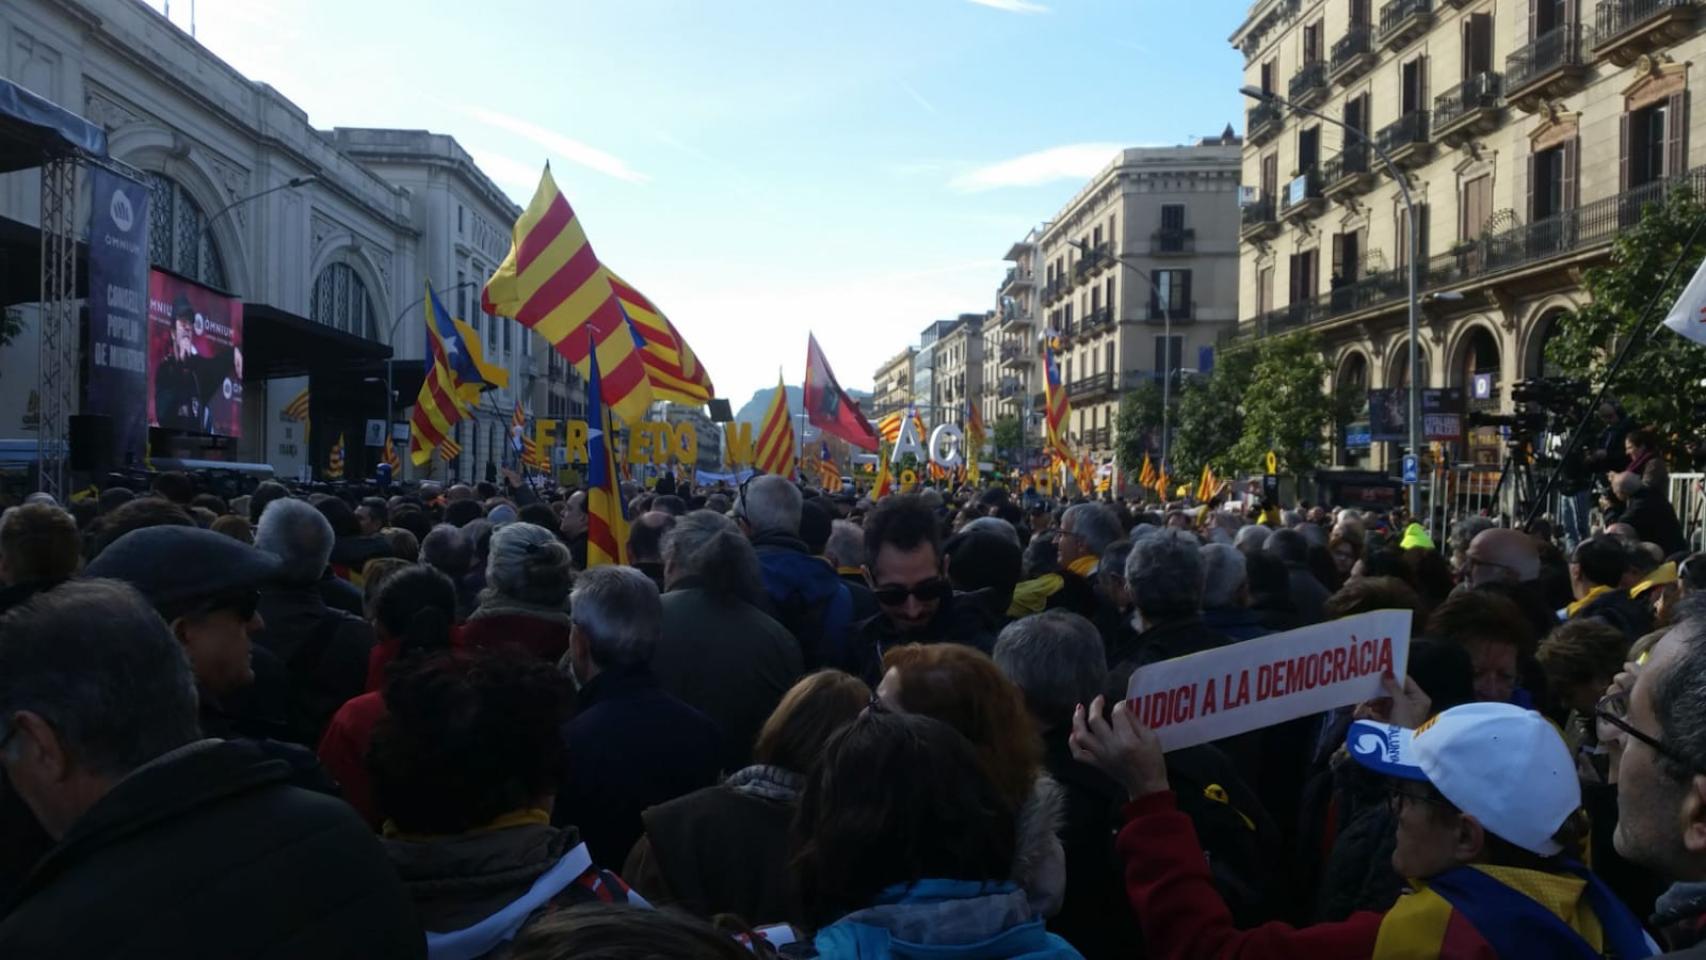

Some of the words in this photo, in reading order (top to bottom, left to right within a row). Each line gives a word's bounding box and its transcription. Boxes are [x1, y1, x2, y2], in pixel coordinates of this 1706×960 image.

[1406, 458, 1414, 469] P
[1202, 678, 1216, 716] A
[1223, 670, 1250, 710] LA
[1256, 635, 1394, 702] DEMOCRÀCIA
